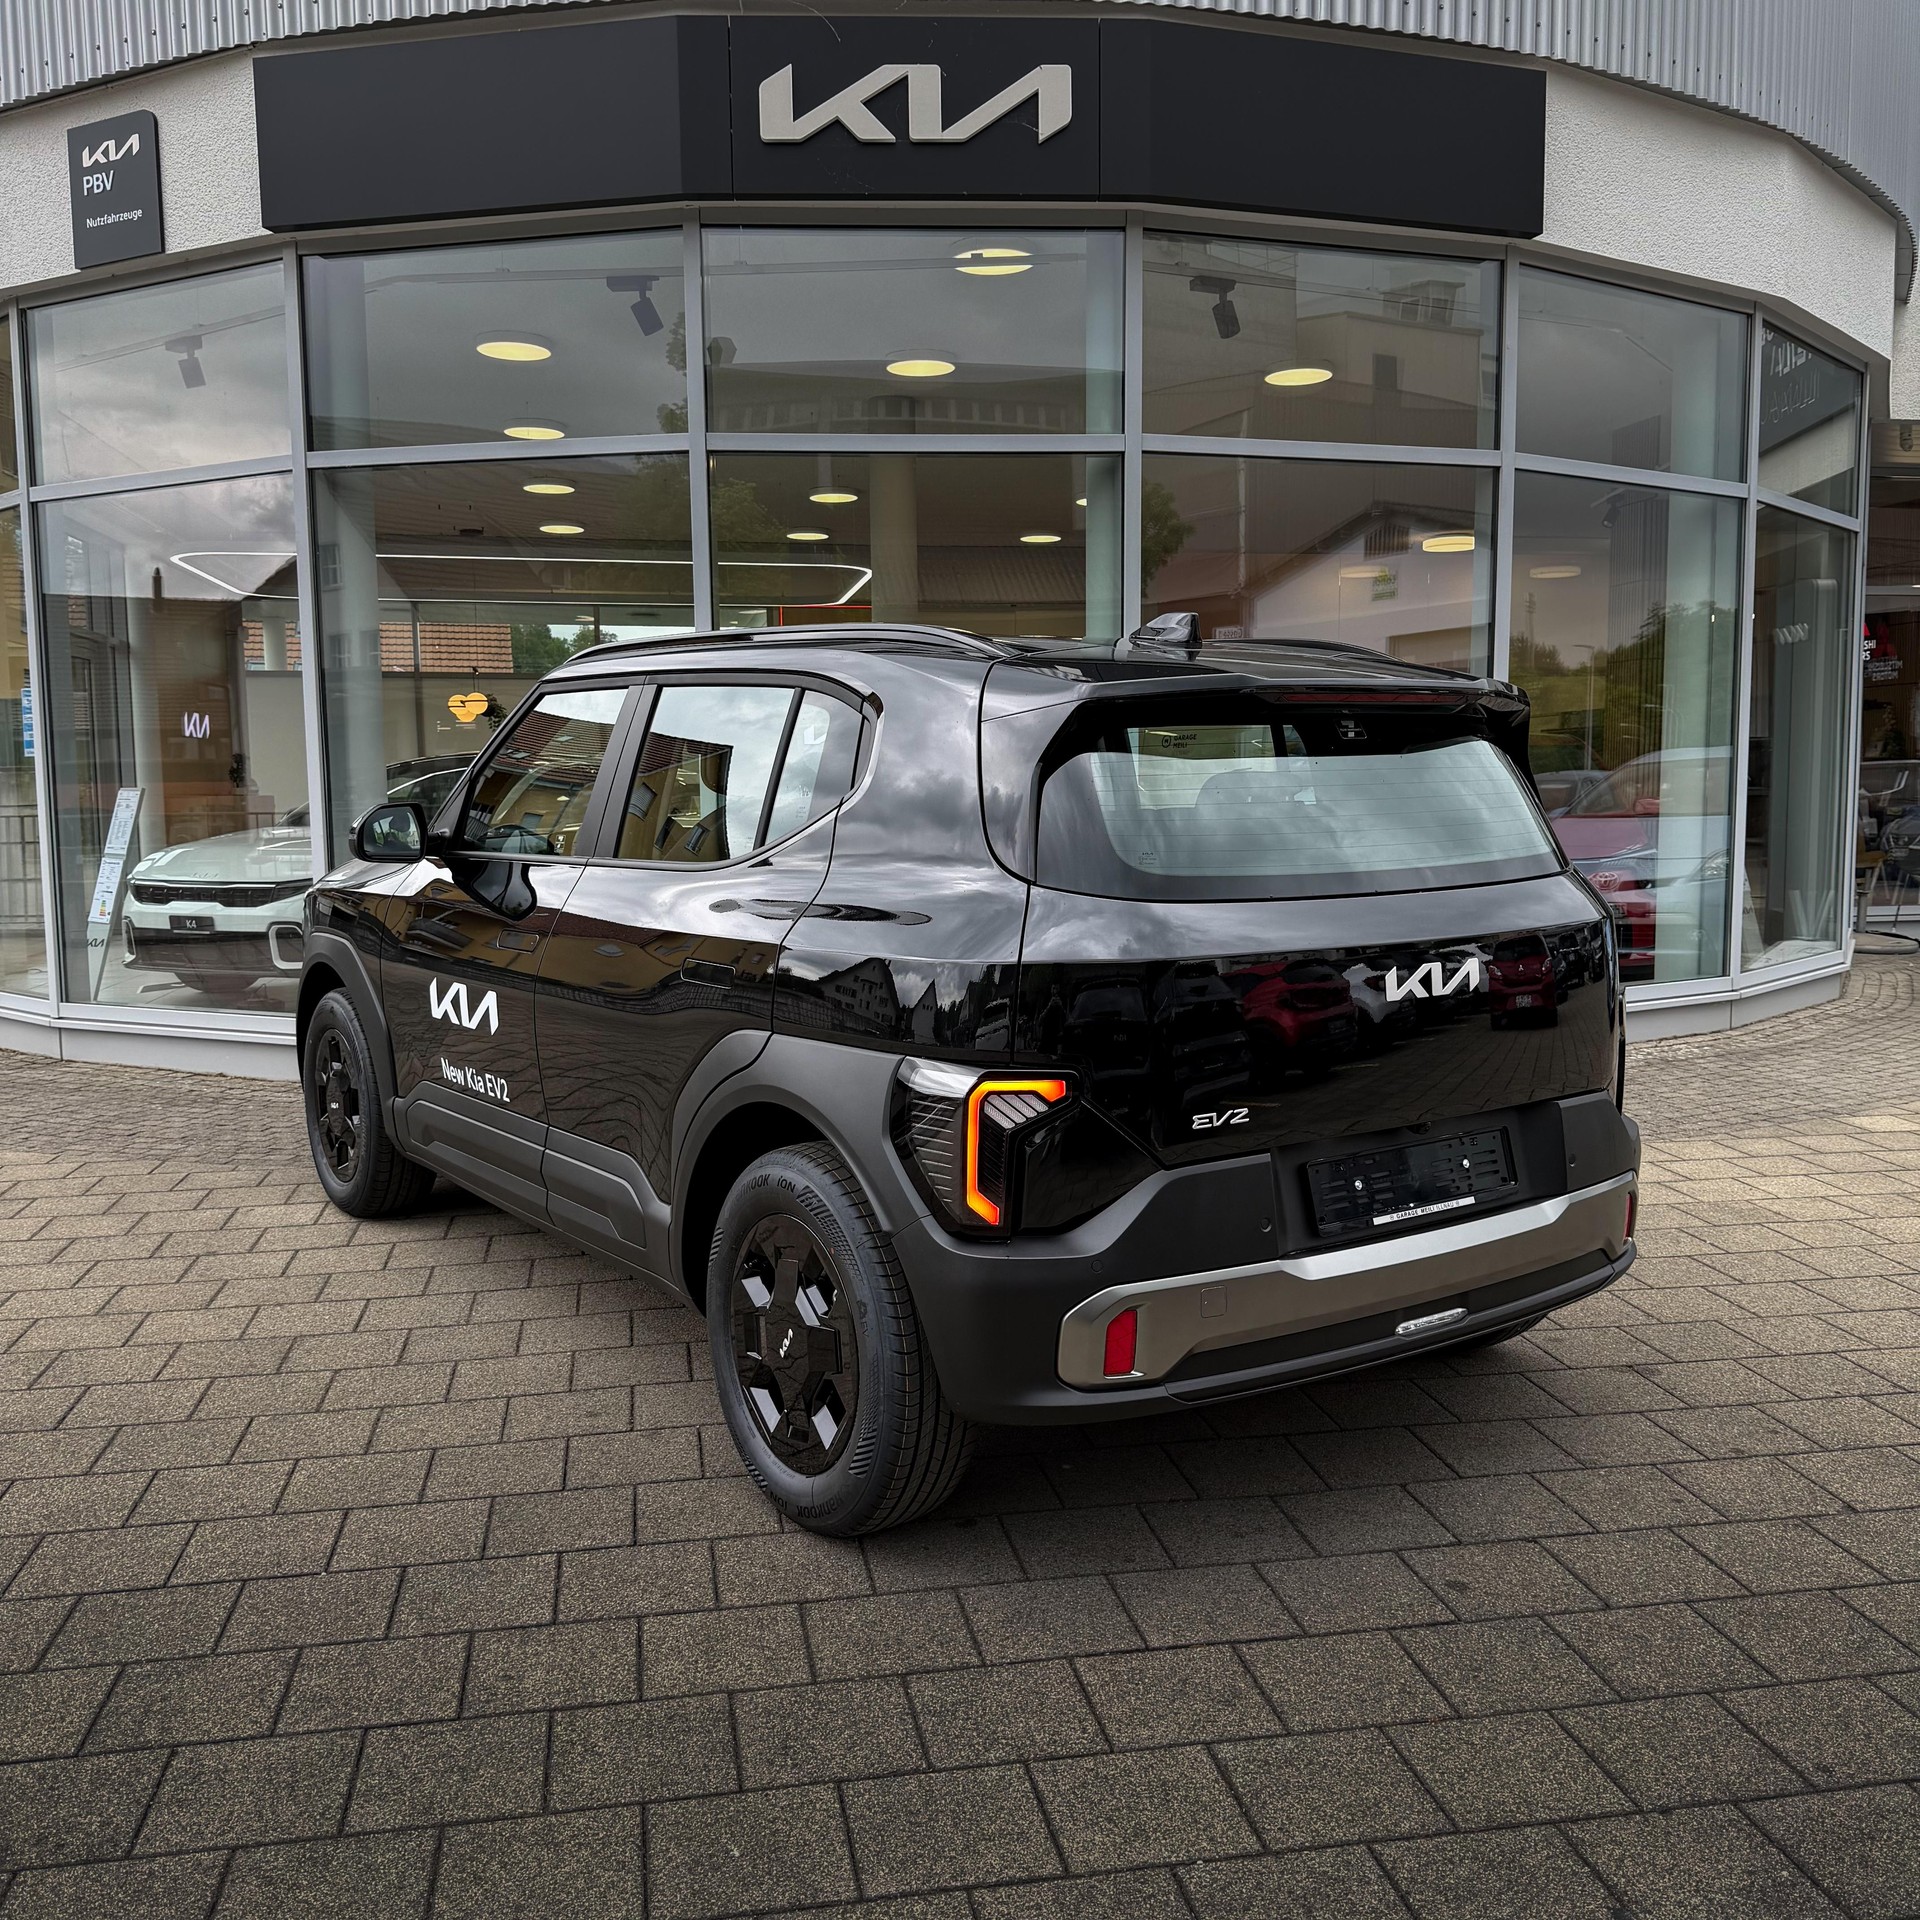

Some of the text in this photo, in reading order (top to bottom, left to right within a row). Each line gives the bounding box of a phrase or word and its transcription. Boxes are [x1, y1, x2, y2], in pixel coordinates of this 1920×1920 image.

[759, 63, 1073, 144] KIA
[82, 133, 140, 168] KIA
[83, 170, 114, 196] PBV
[86, 209, 143, 229] Nutzfahrzeuge
[183, 711, 210, 739] KIA
[1173, 733, 1197, 742] GARAGE
[1385, 957, 1480, 1002] KIA
[429, 976, 499, 1036] KIA
[441, 1057, 511, 1103] New Kia EV2
[1192, 1107, 1250, 1130] EV2
[1396, 1209, 1419, 1220] GARAGE
[1420, 1205, 1436, 1215] MEILI
